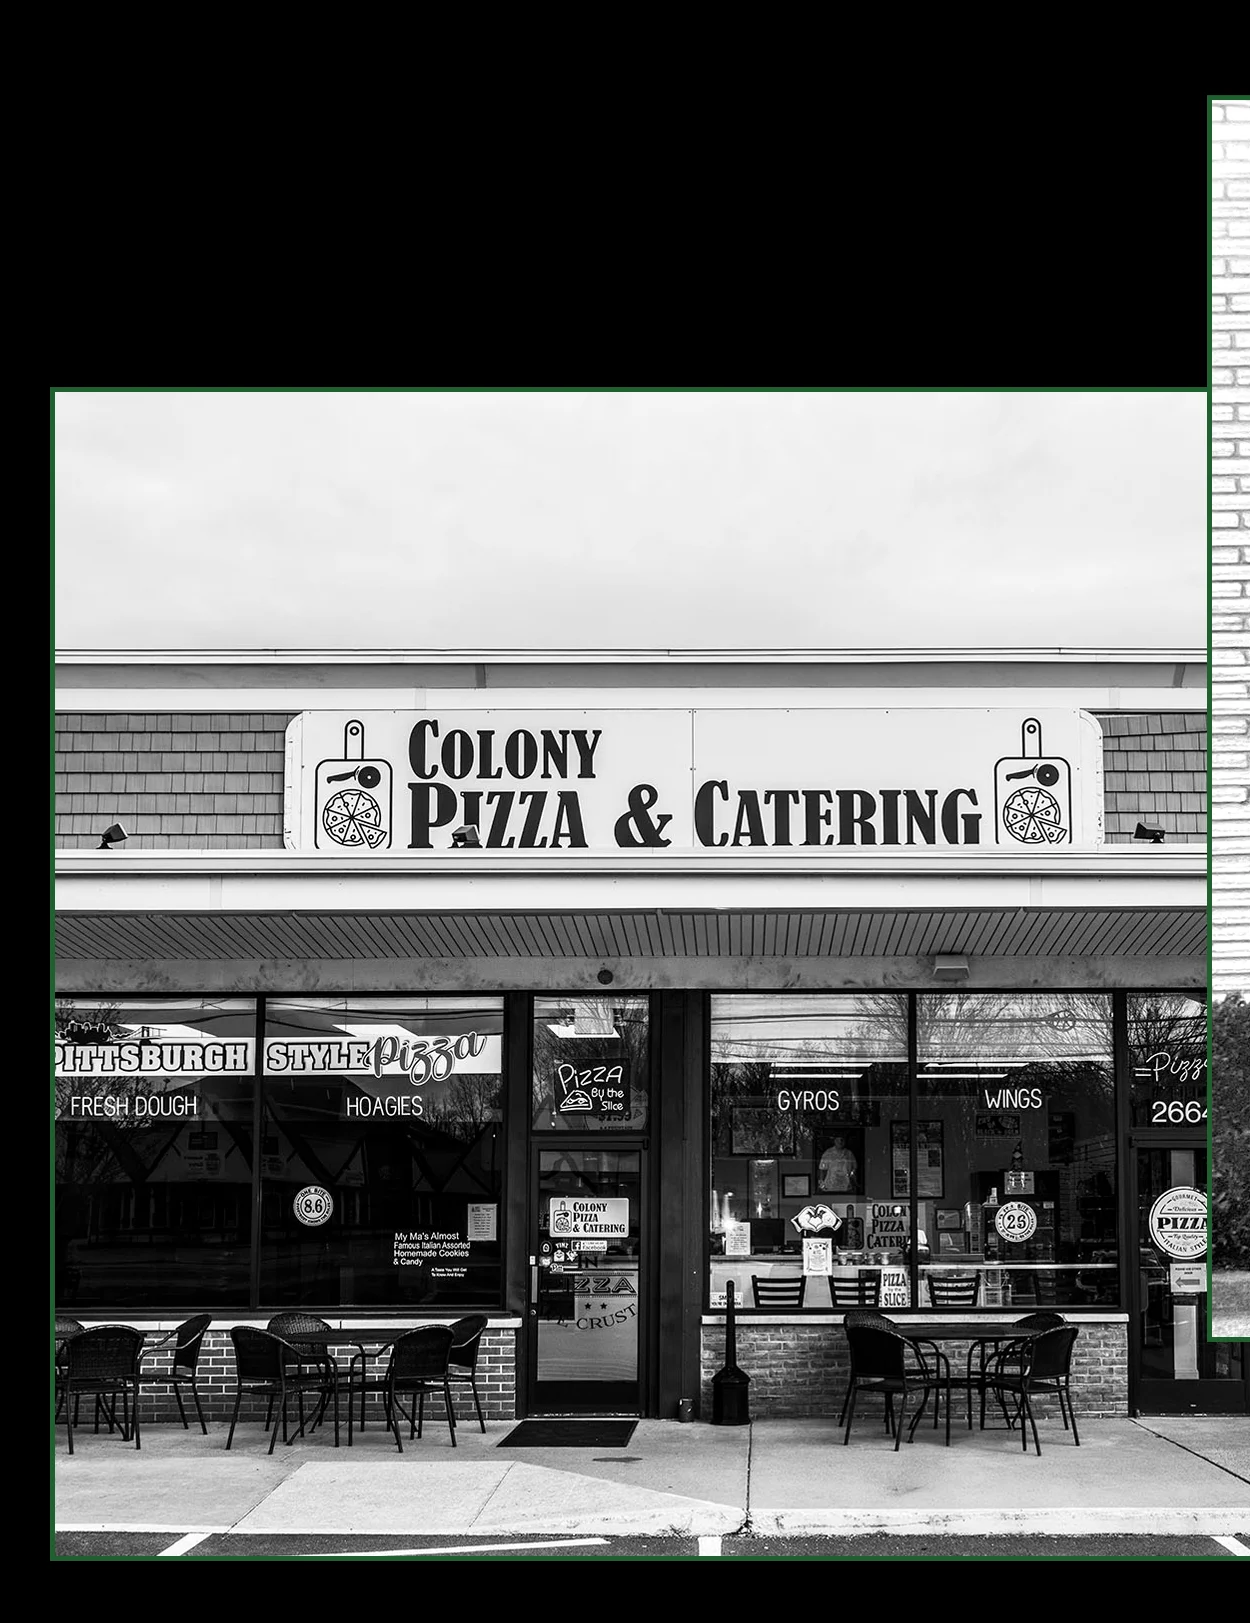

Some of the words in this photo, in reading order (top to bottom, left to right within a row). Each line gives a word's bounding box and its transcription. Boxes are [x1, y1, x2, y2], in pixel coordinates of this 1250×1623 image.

[407, 719, 603, 779] COLONY
[407, 782, 590, 849] PIZZA
[613, 783, 673, 848] &
[694, 780, 983, 847] CATERING
[266, 1041, 370, 1072] STYLE
[591, 1087, 605, 1101] By
[606, 1088, 625, 1098] the
[777, 1090, 840, 1111] GYROS
[984, 1088, 1042, 1109] WINGS
[71, 1095, 129, 1117] FRESH
[135, 1095, 197, 1117] DOUGH
[346, 1095, 424, 1117] HOAGIES
[600, 1101, 624, 1111] Slice
[304, 1199, 323, 1213] 8.6
[573, 1202, 608, 1213] COLONY
[573, 1213, 599, 1223] PIZZA
[572, 1223, 580, 1233] &
[583, 1222, 626, 1233] CATERING
[872, 1219, 905, 1234] PIZZA
[394, 1232, 408, 1242] My
[409, 1232, 429, 1241] Ma's
[430, 1231, 460, 1241] Almost
[393, 1241, 420, 1250] Famous
[421, 1241, 441, 1250] Italian
[441, 1241, 471, 1250] Assorted
[1163, 1238, 1187, 1252] ITALIAN
[393, 1249, 437, 1258] Homemade
[438, 1249, 470, 1258] Cookies
[400, 1258, 424, 1267] Candy
[883, 1273, 907, 1287] PIZZA
[883, 1292, 907, 1306] SLICE
[576, 1303, 638, 1330] CRUST
